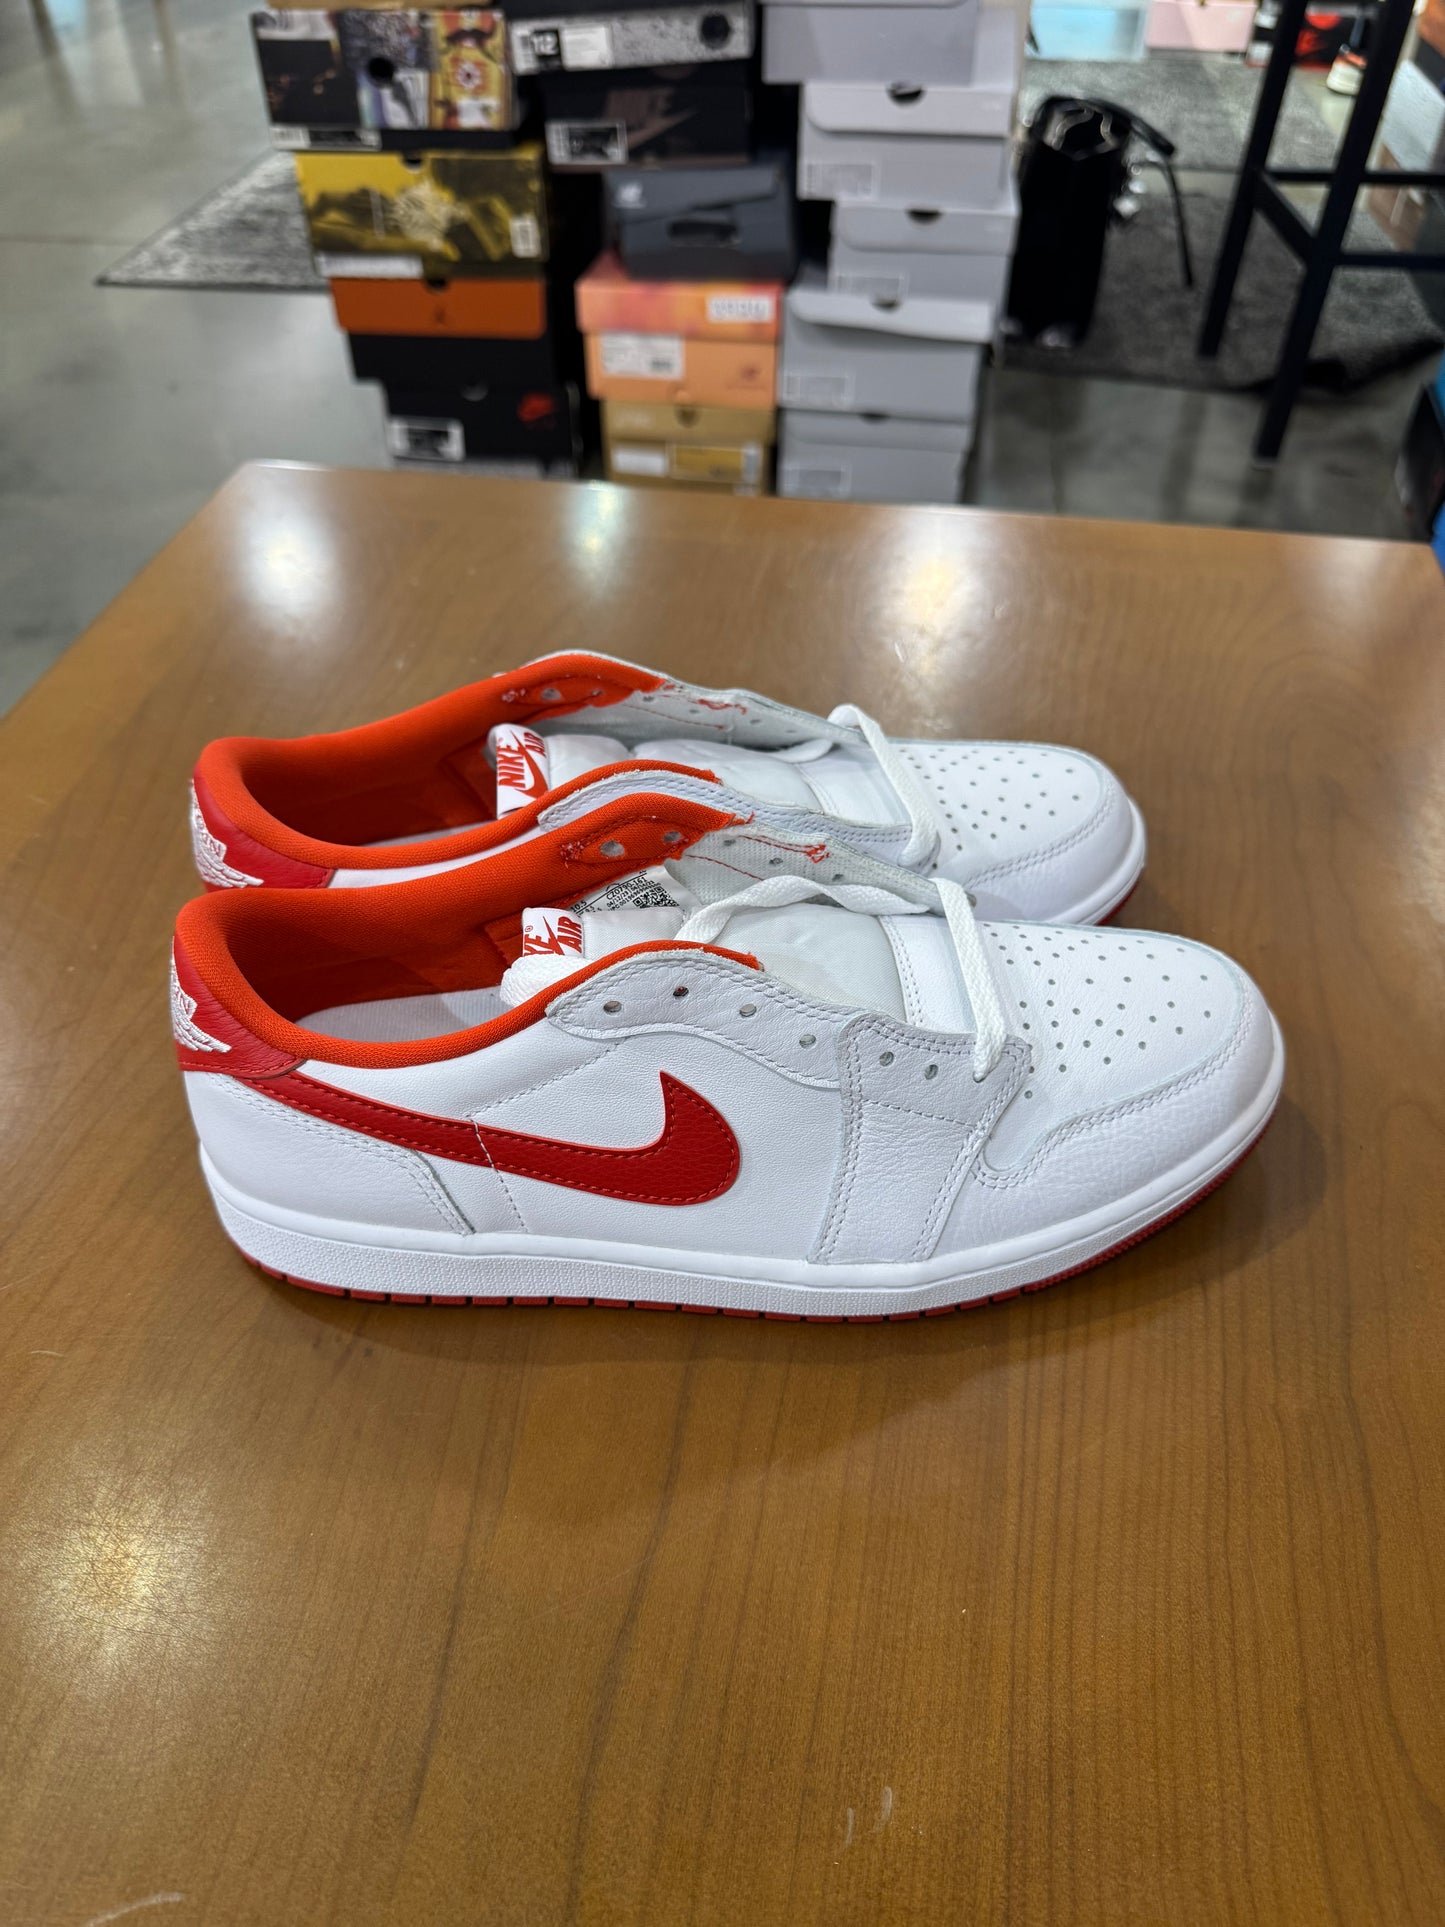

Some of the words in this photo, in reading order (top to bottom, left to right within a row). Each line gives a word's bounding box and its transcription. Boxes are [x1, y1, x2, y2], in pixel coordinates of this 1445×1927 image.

[495, 743, 526, 789] NIKE
[606, 876, 648, 900] CZ0790-161
[570, 900, 588, 912] 10.5
[557, 916, 582, 954] AIR
